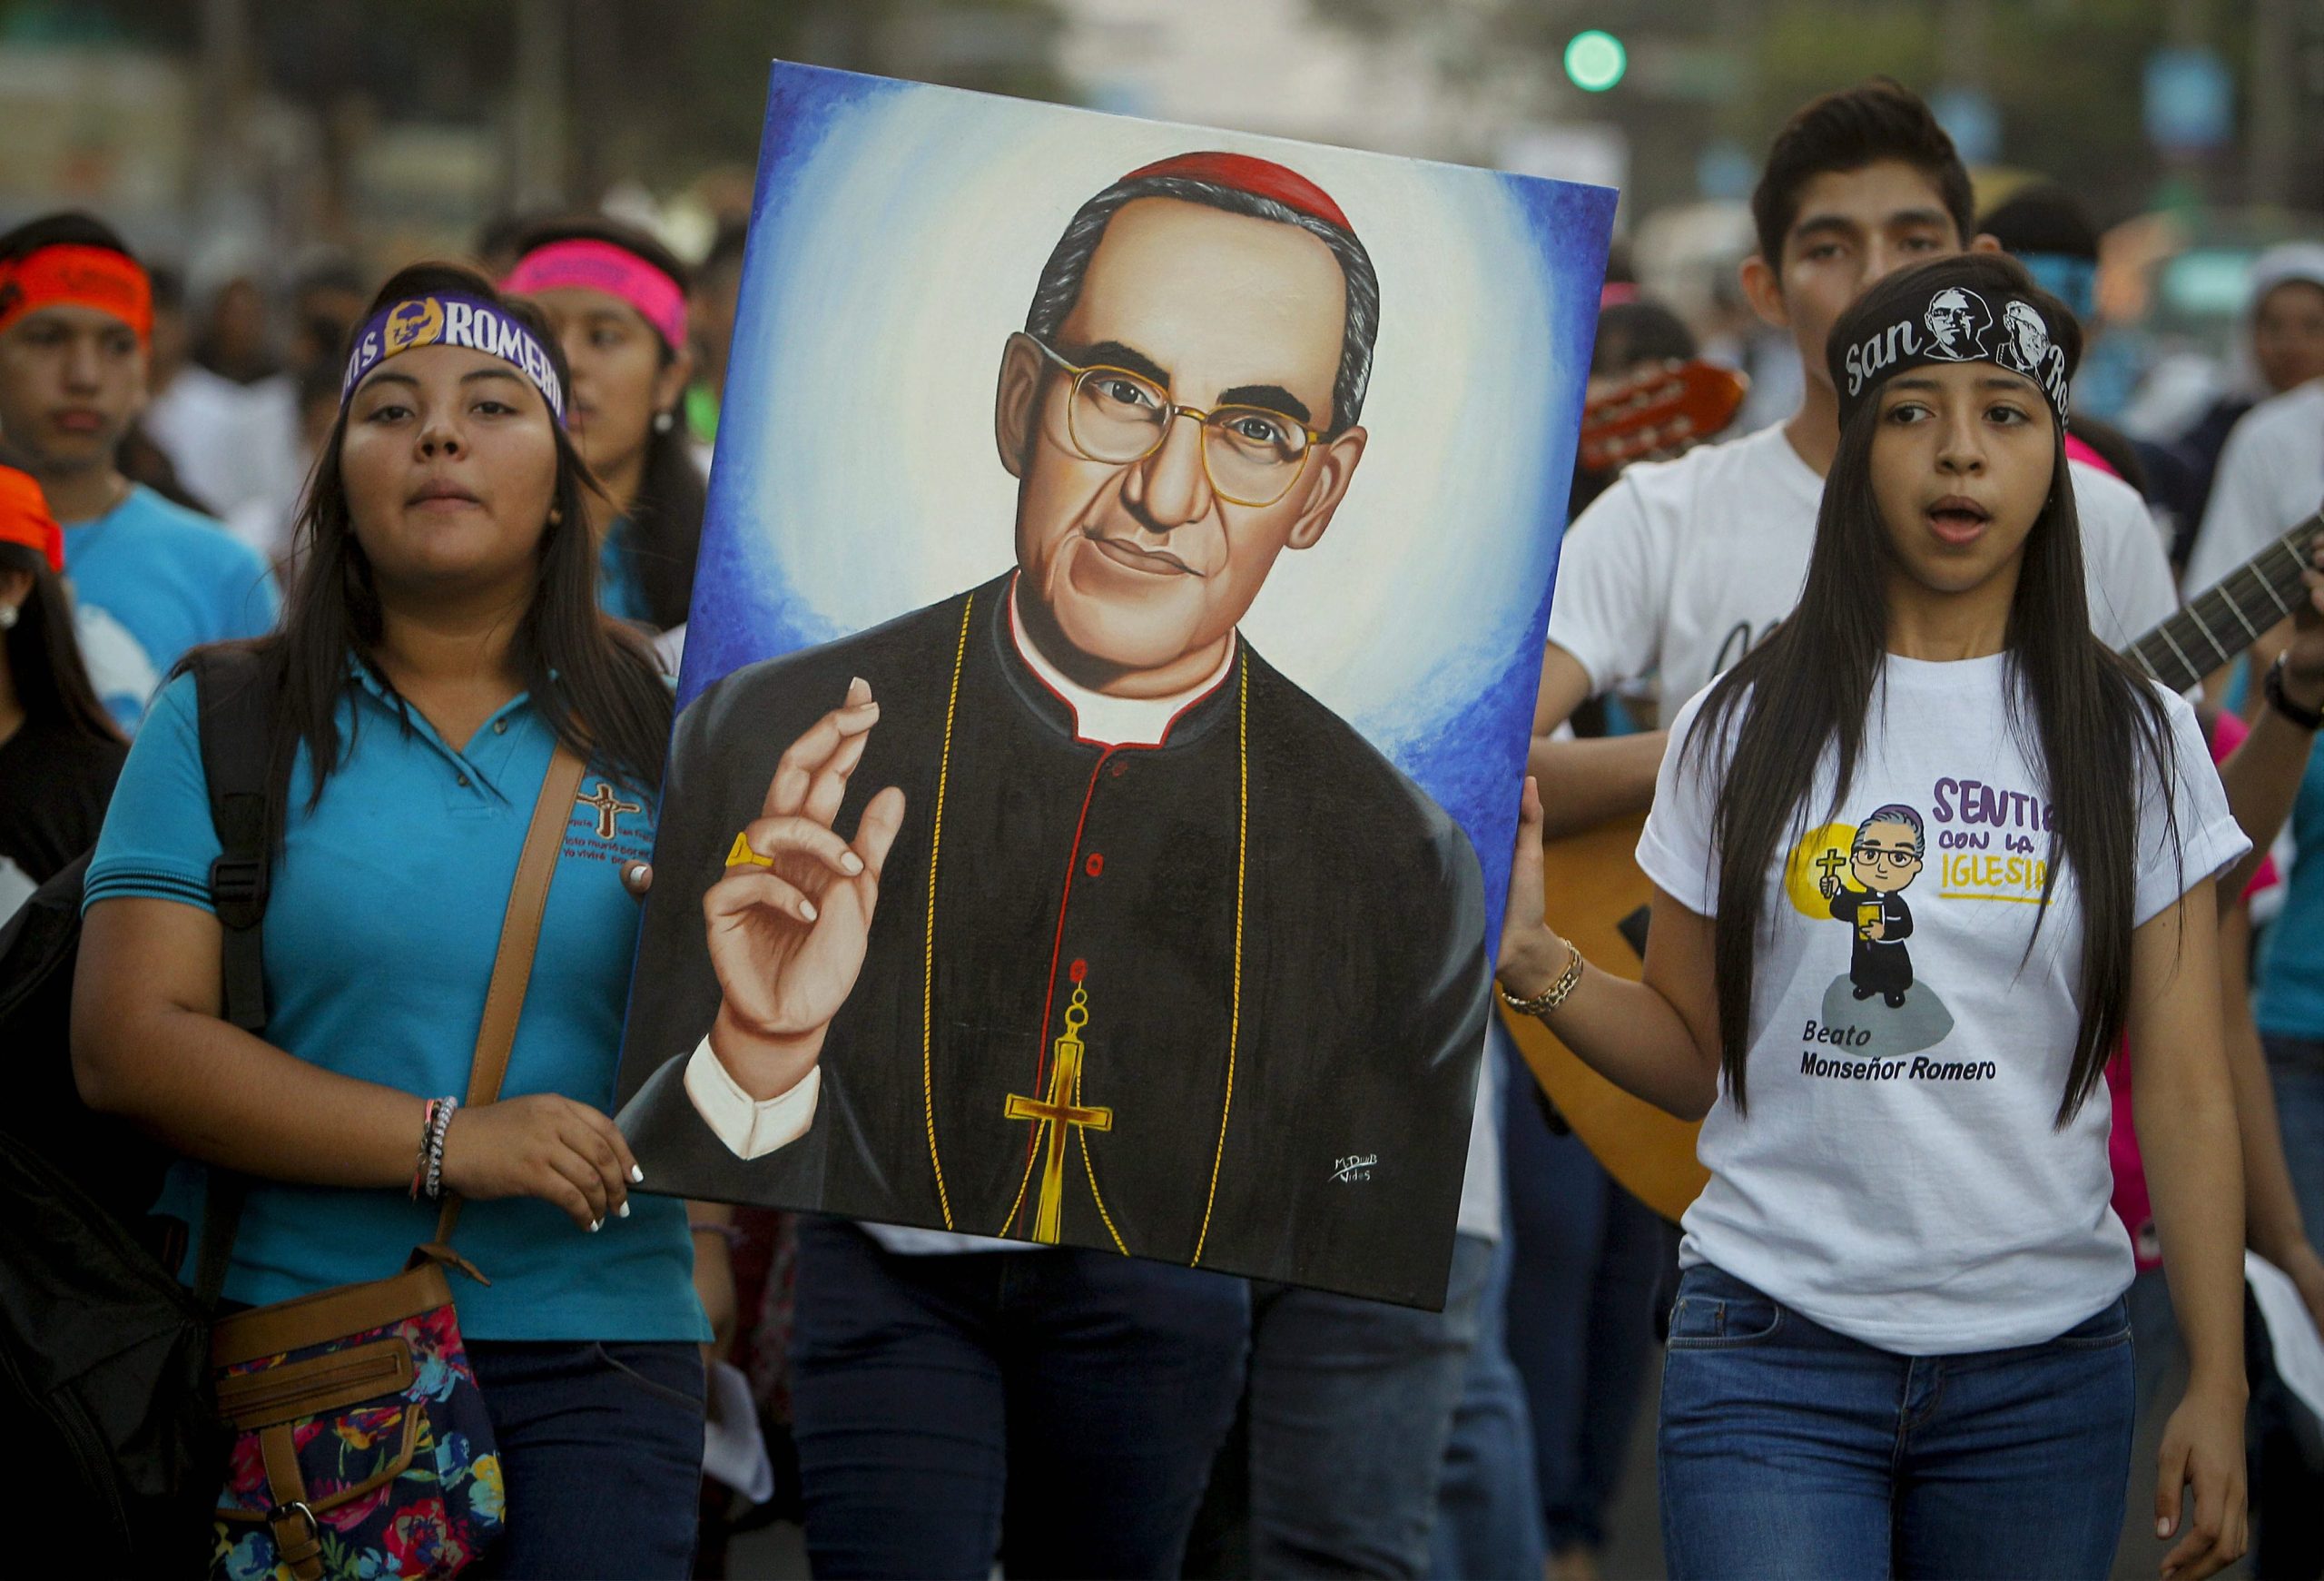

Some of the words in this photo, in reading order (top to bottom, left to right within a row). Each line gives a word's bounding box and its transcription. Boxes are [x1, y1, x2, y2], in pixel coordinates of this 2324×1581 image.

[1938, 830, 1990, 850] CON
[2004, 833, 2034, 855] LA
[1802, 1019, 1871, 1047] Beato
[1801, 1052, 1906, 1081] Monseñor
[1909, 1056, 1996, 1081] Romero
